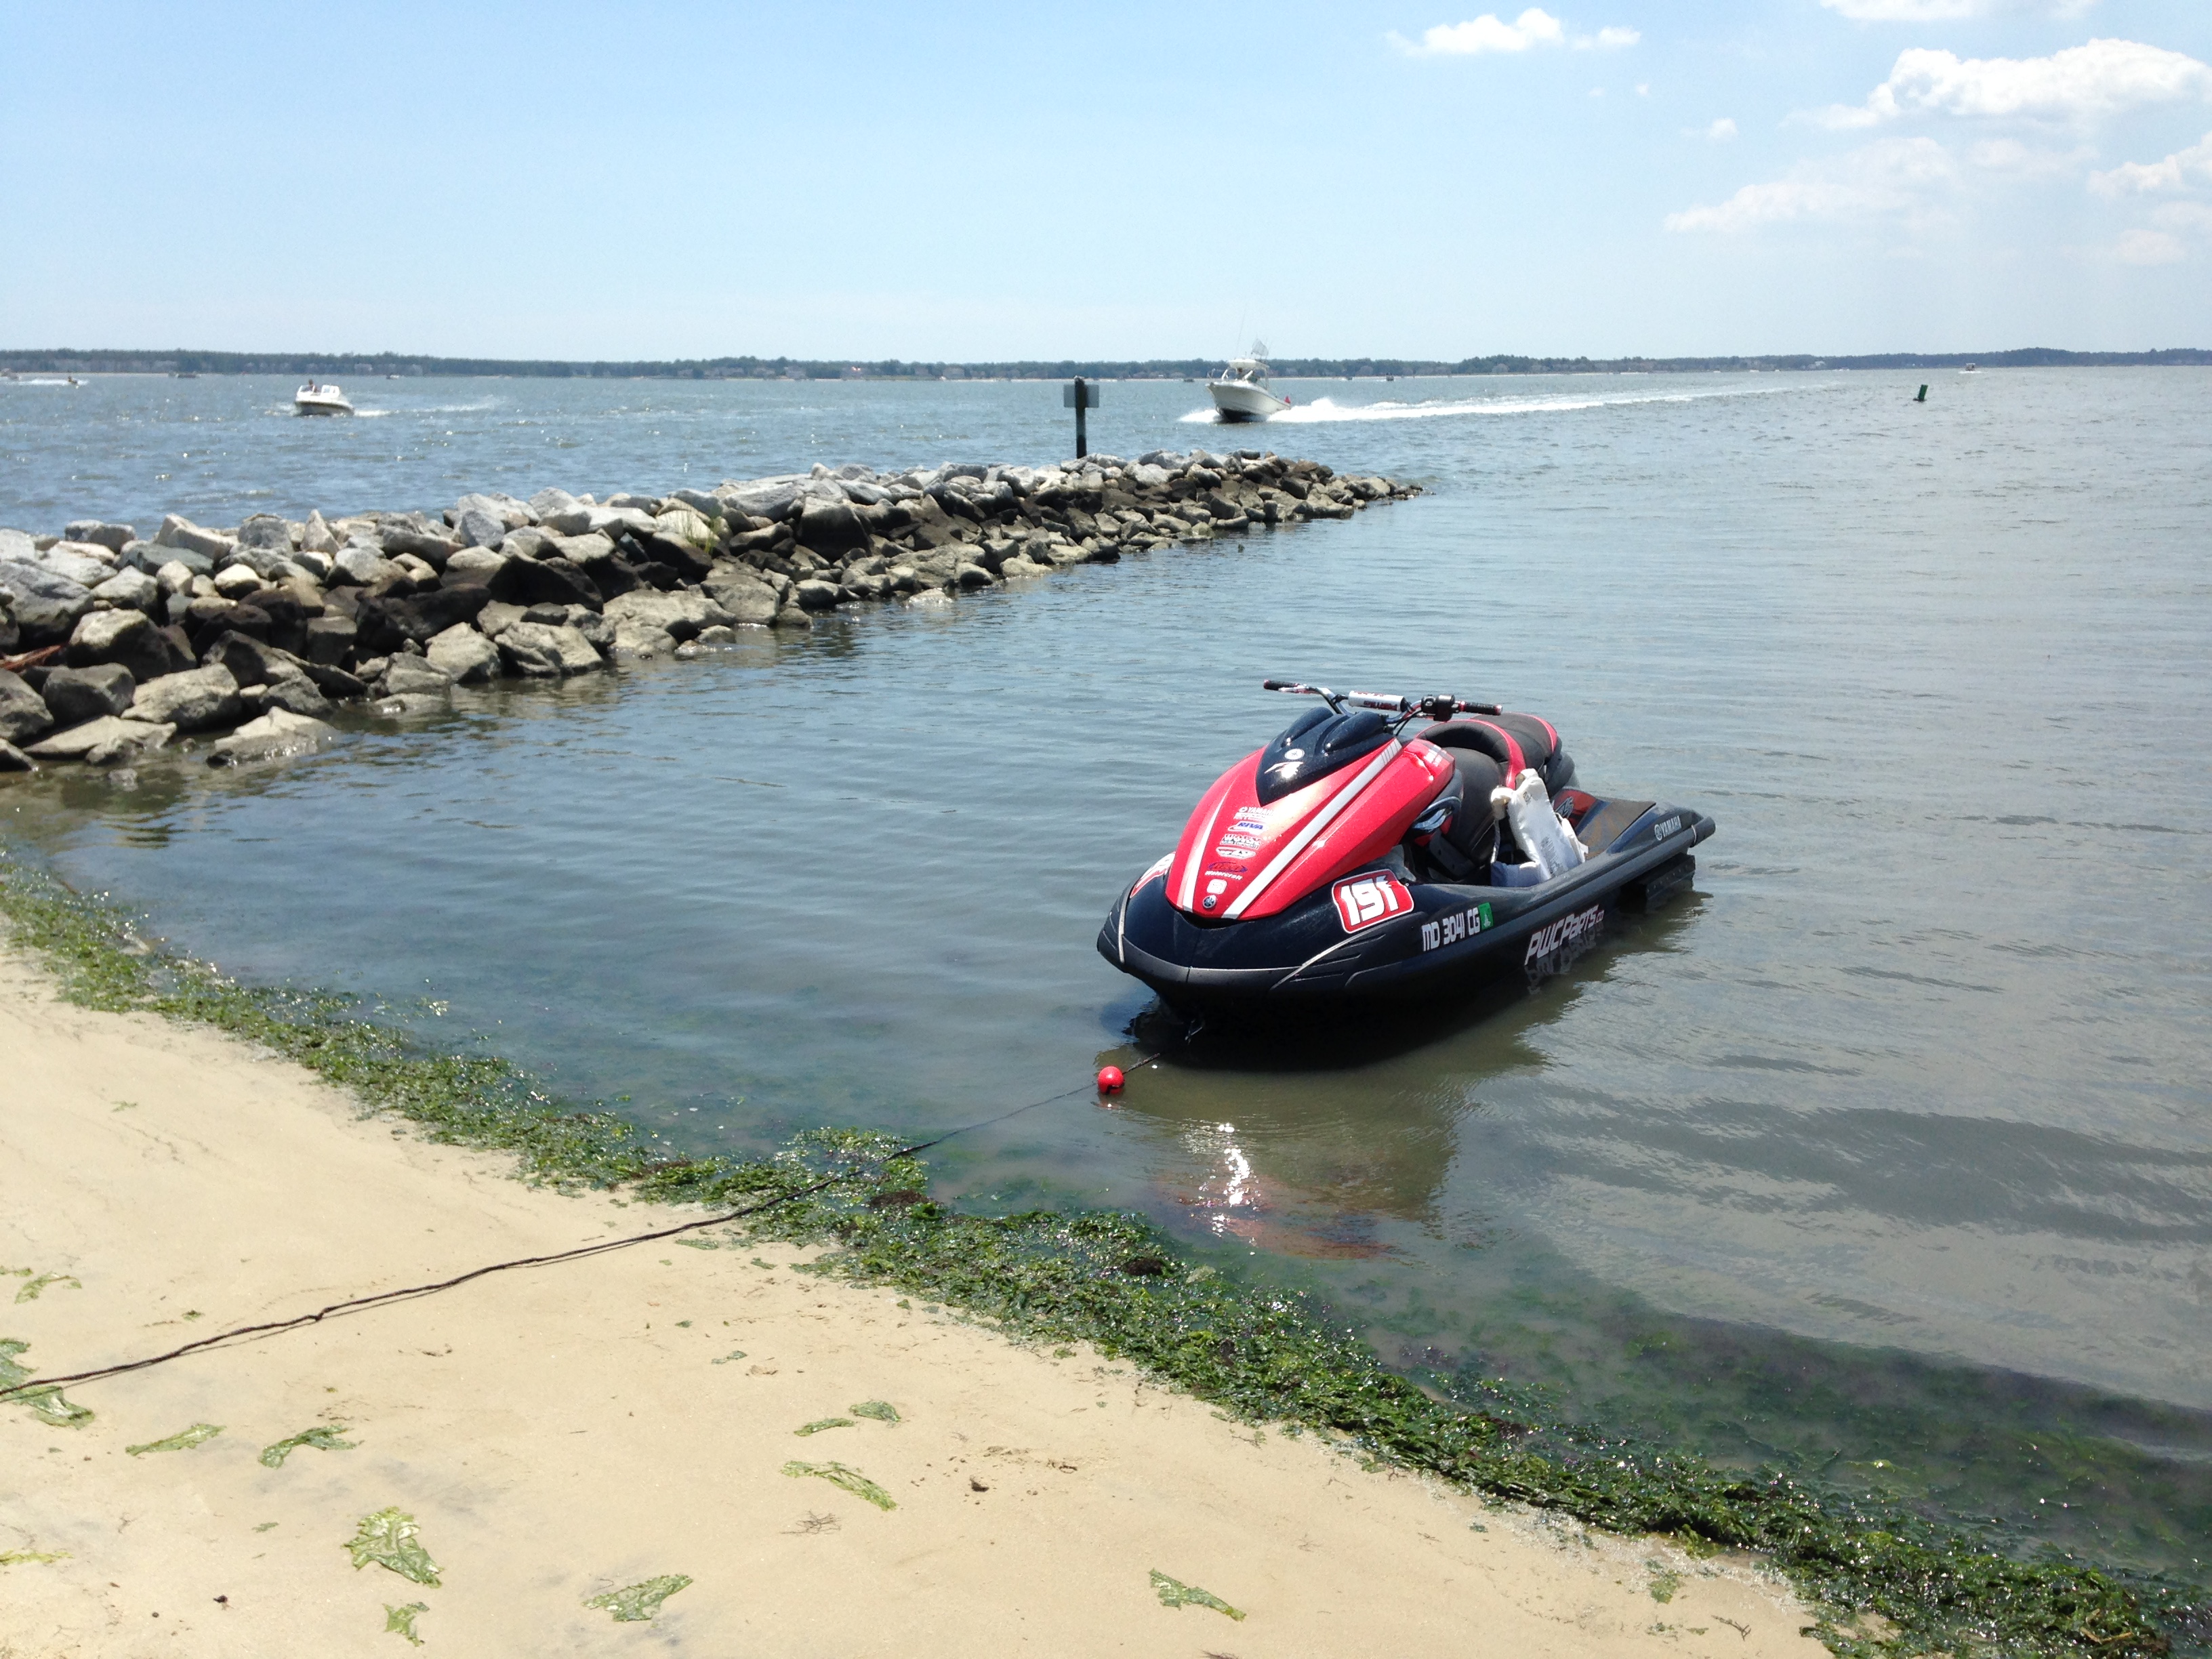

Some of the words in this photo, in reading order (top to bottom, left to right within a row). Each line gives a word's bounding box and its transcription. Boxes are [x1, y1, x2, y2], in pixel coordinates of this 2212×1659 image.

[1660, 815, 1682, 838] YAMAHA
[1204, 871, 1244, 880] Watercraft
[1340, 875, 1399, 926] 191
[1422, 921, 1441, 952] MD
[1442, 912, 1465, 945] 3041
[1467, 907, 1481, 936] CG
